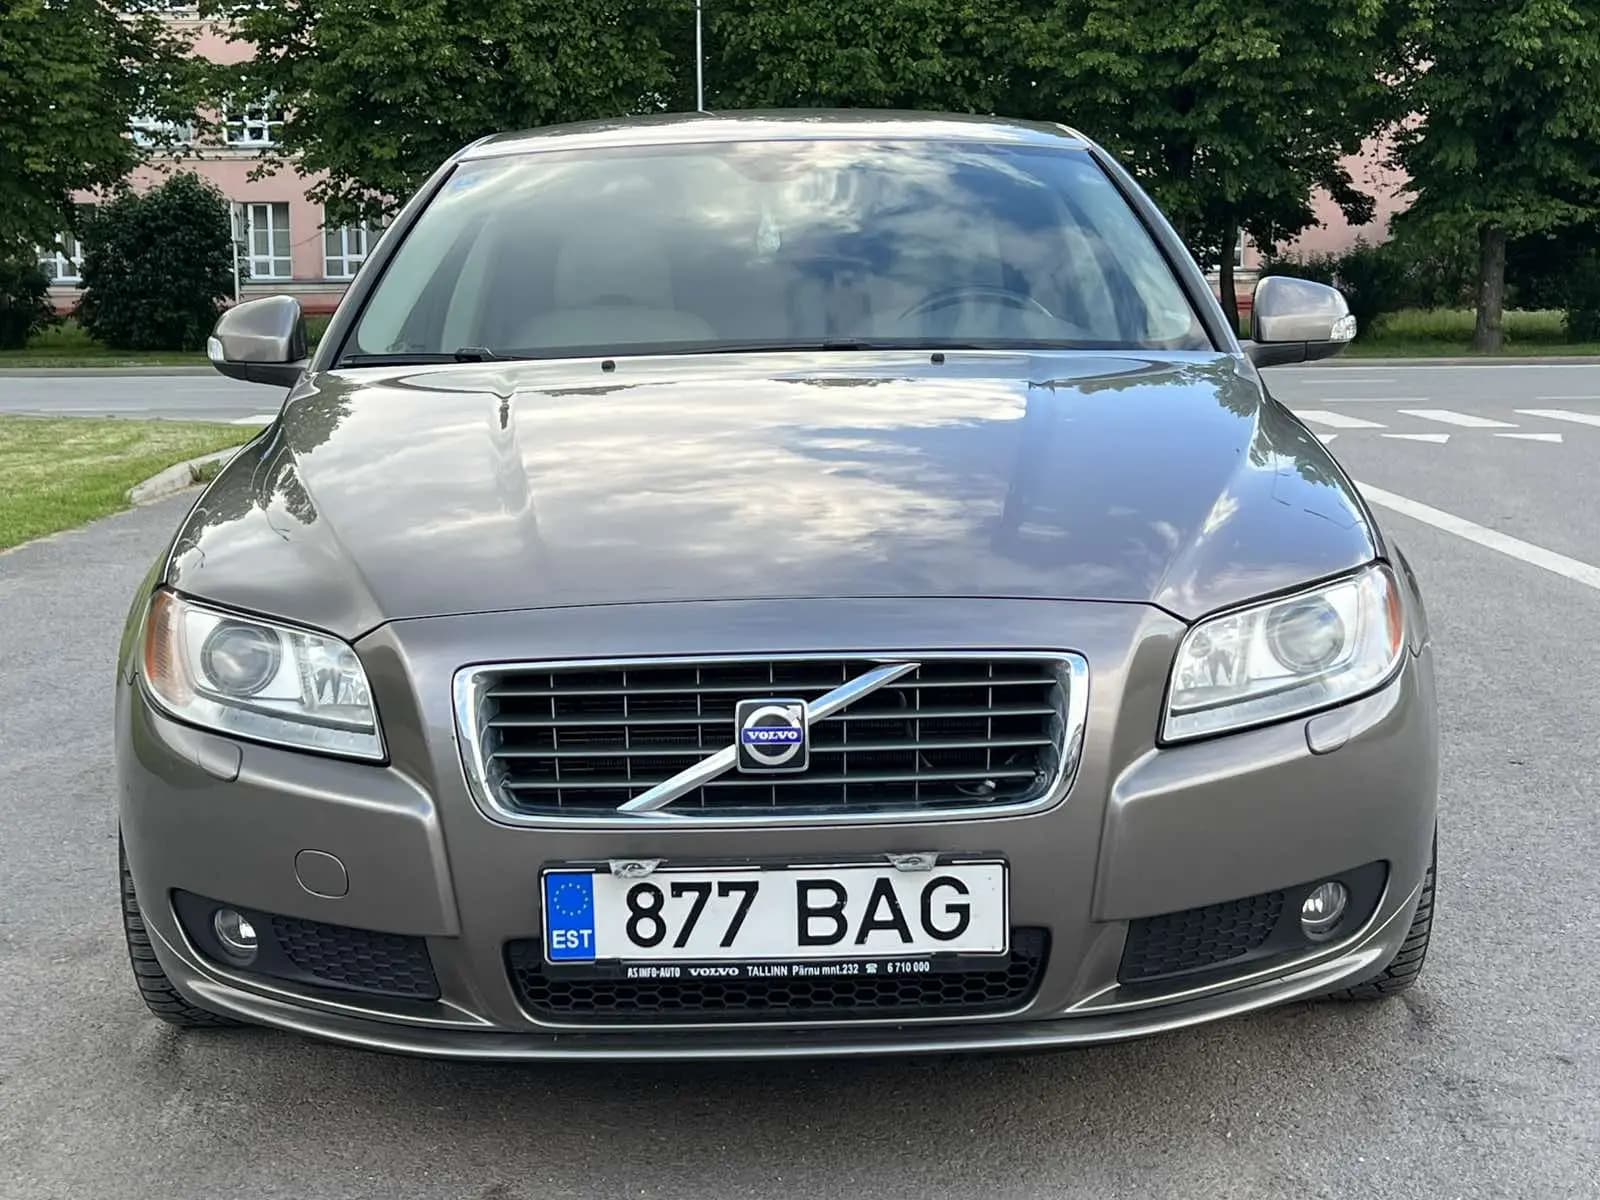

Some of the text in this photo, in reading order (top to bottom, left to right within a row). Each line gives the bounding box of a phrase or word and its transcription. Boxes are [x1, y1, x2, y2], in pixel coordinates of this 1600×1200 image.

[747, 731, 798, 740] VOLVO
[626, 876, 971, 948] 877 BAG
[553, 930, 592, 949] EST
[688, 967, 739, 976] VOLVO
[747, 965, 788, 977] TALLINN
